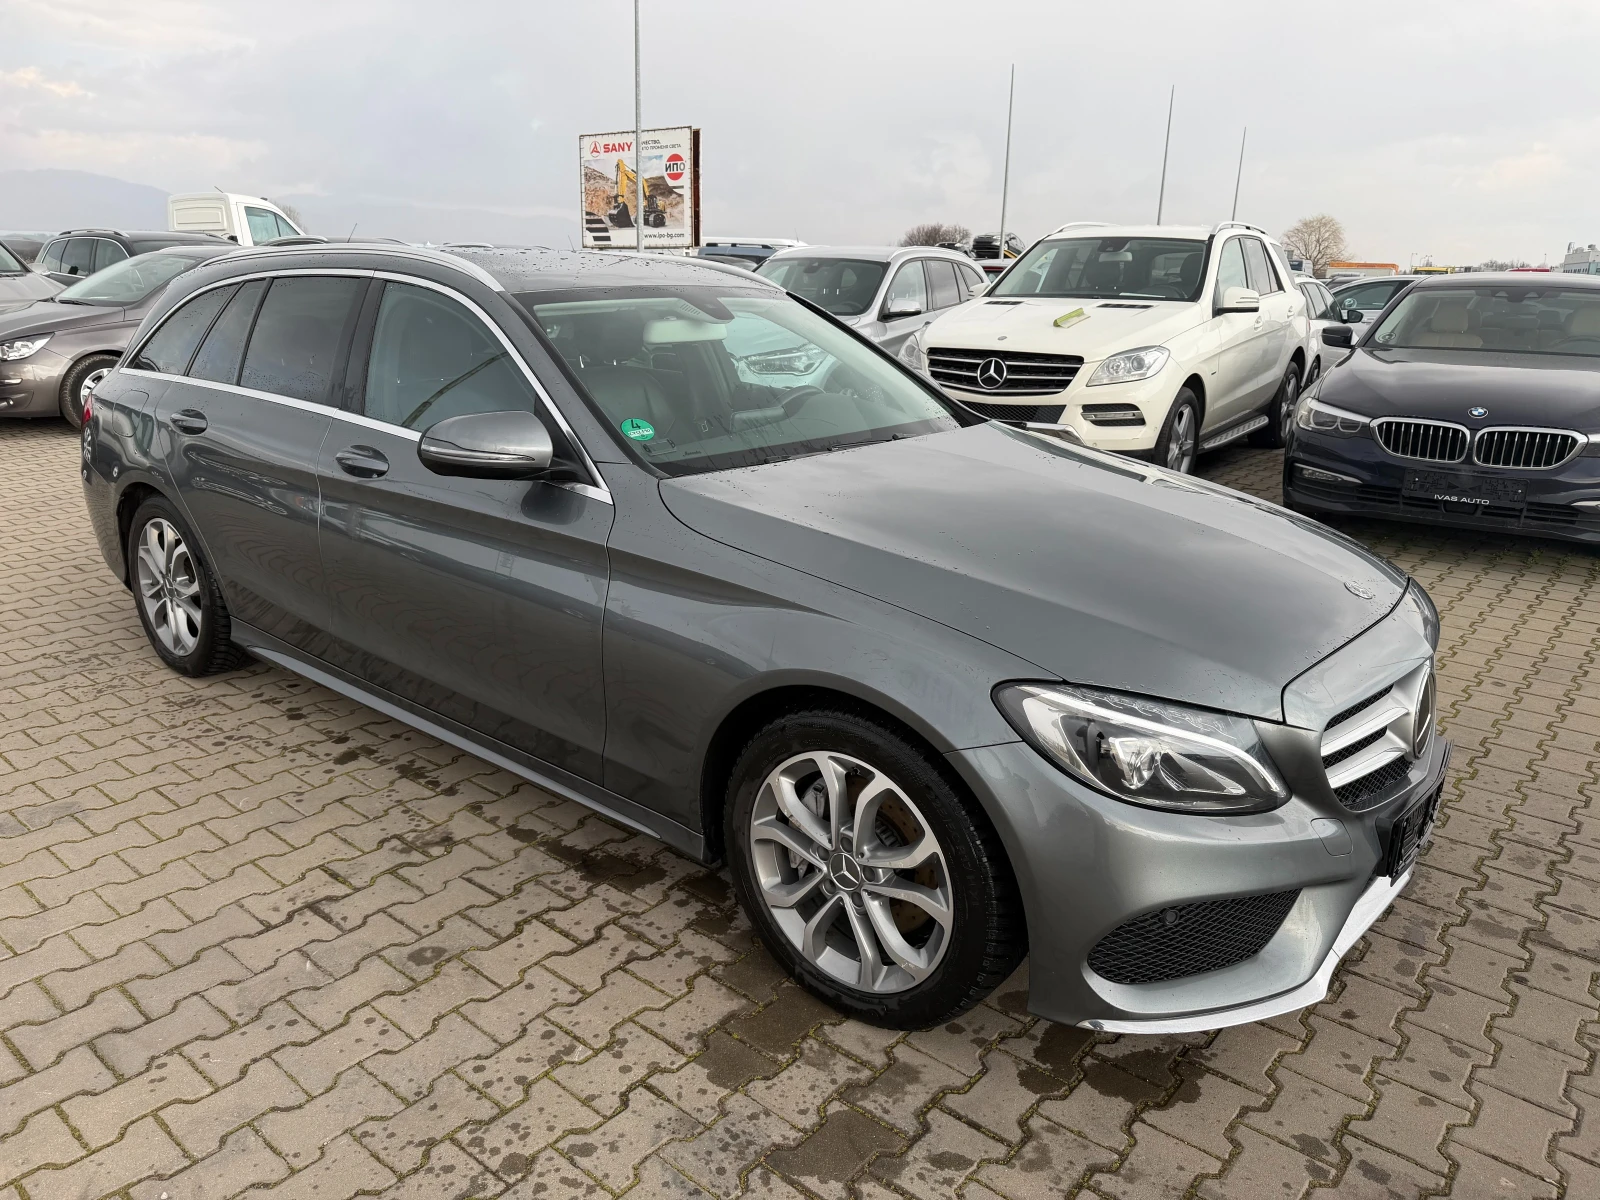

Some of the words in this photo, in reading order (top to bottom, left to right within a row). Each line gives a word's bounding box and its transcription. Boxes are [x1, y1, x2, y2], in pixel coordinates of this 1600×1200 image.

[603, 142, 633, 153] SANY
[665, 162, 685, 172] ИПО
[644, 232, 684, 240] www.ipo-bg.com
[631, 419, 641, 429] 4
[1434, 494, 1458, 502] IVAS
[1460, 497, 1490, 505] AUTO
